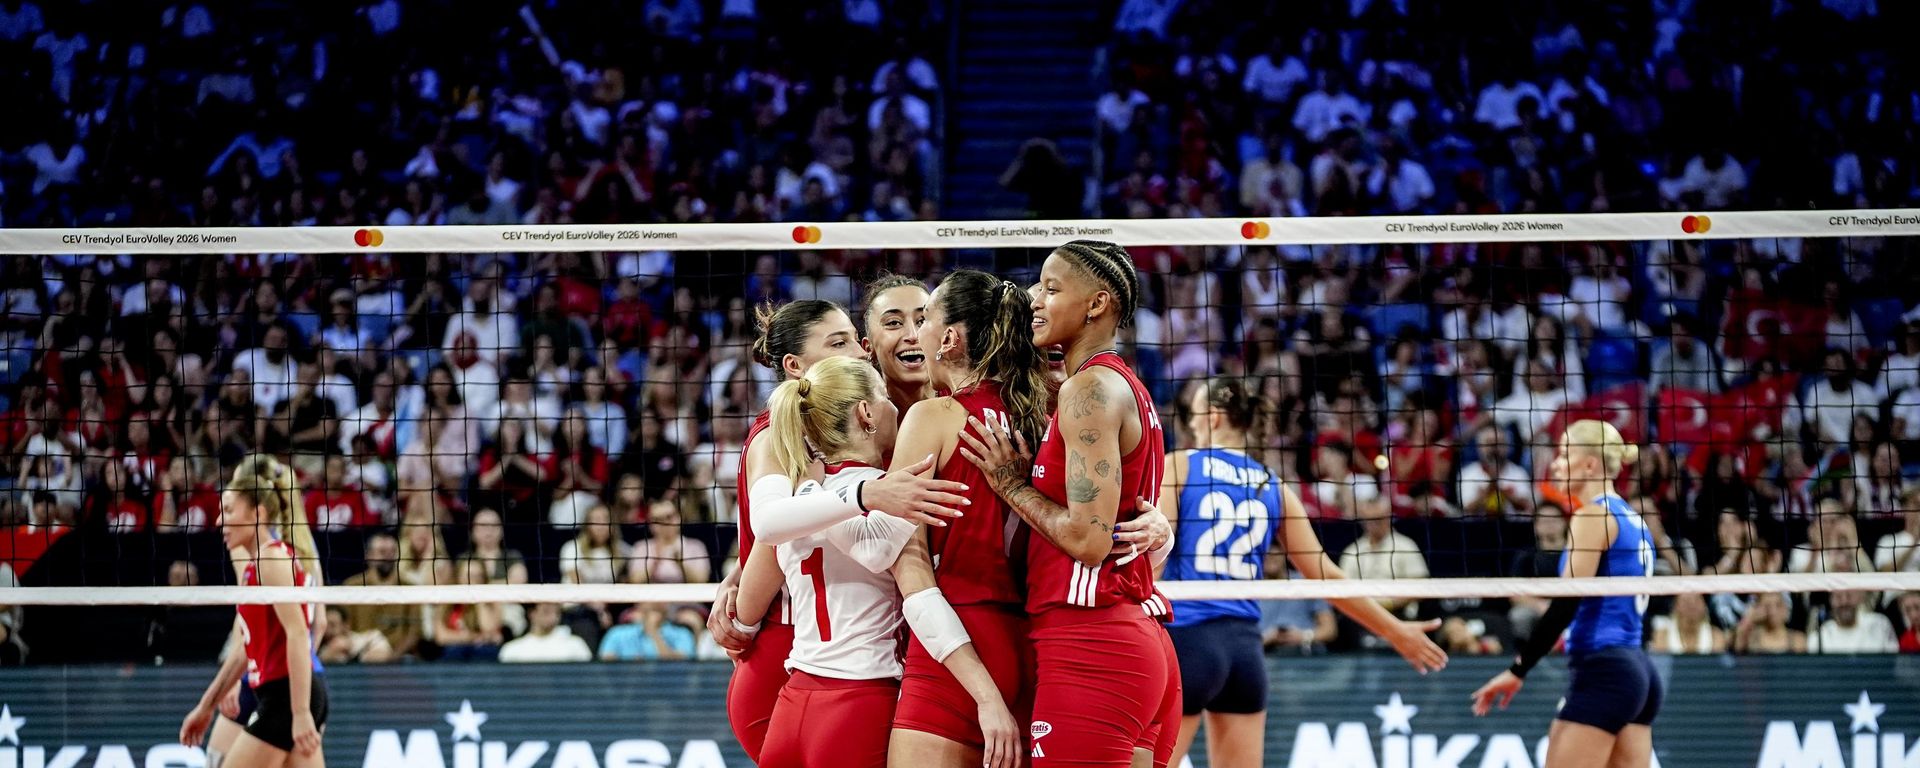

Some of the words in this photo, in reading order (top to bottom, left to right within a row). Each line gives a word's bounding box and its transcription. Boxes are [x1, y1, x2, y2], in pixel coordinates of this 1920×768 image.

[1385, 223, 1406, 233] CEV
[1408, 222, 1449, 234] Trendyol
[1450, 221, 1500, 233] EuroVolley
[1502, 221, 1526, 231] 2026
[1527, 221, 1564, 231] Women
[1828, 216, 1850, 226] CEV
[1851, 215, 1893, 227] Trendyol
[502, 231, 523, 241] CEV
[524, 231, 565, 243] Trendyol
[566, 231, 616, 242] EuroVolley
[617, 230, 640, 240] 2026
[642, 230, 678, 240] Women
[936, 228, 957, 238] CEV
[958, 227, 999, 239] Trendyol
[1001, 227, 1050, 238] EuroVolley
[1052, 226, 1075, 236] 2026
[1076, 226, 1113, 236] Women
[62, 234, 83, 244] CEV
[84, 234, 124, 246] Trendyol
[126, 234, 175, 246] EuroVolley
[176, 234, 199, 243] 2026
[201, 233, 237, 243] Women
[1032, 465, 1046, 479] ne
[1195, 491, 1269, 580] 22
[801, 547, 832, 642] 1
